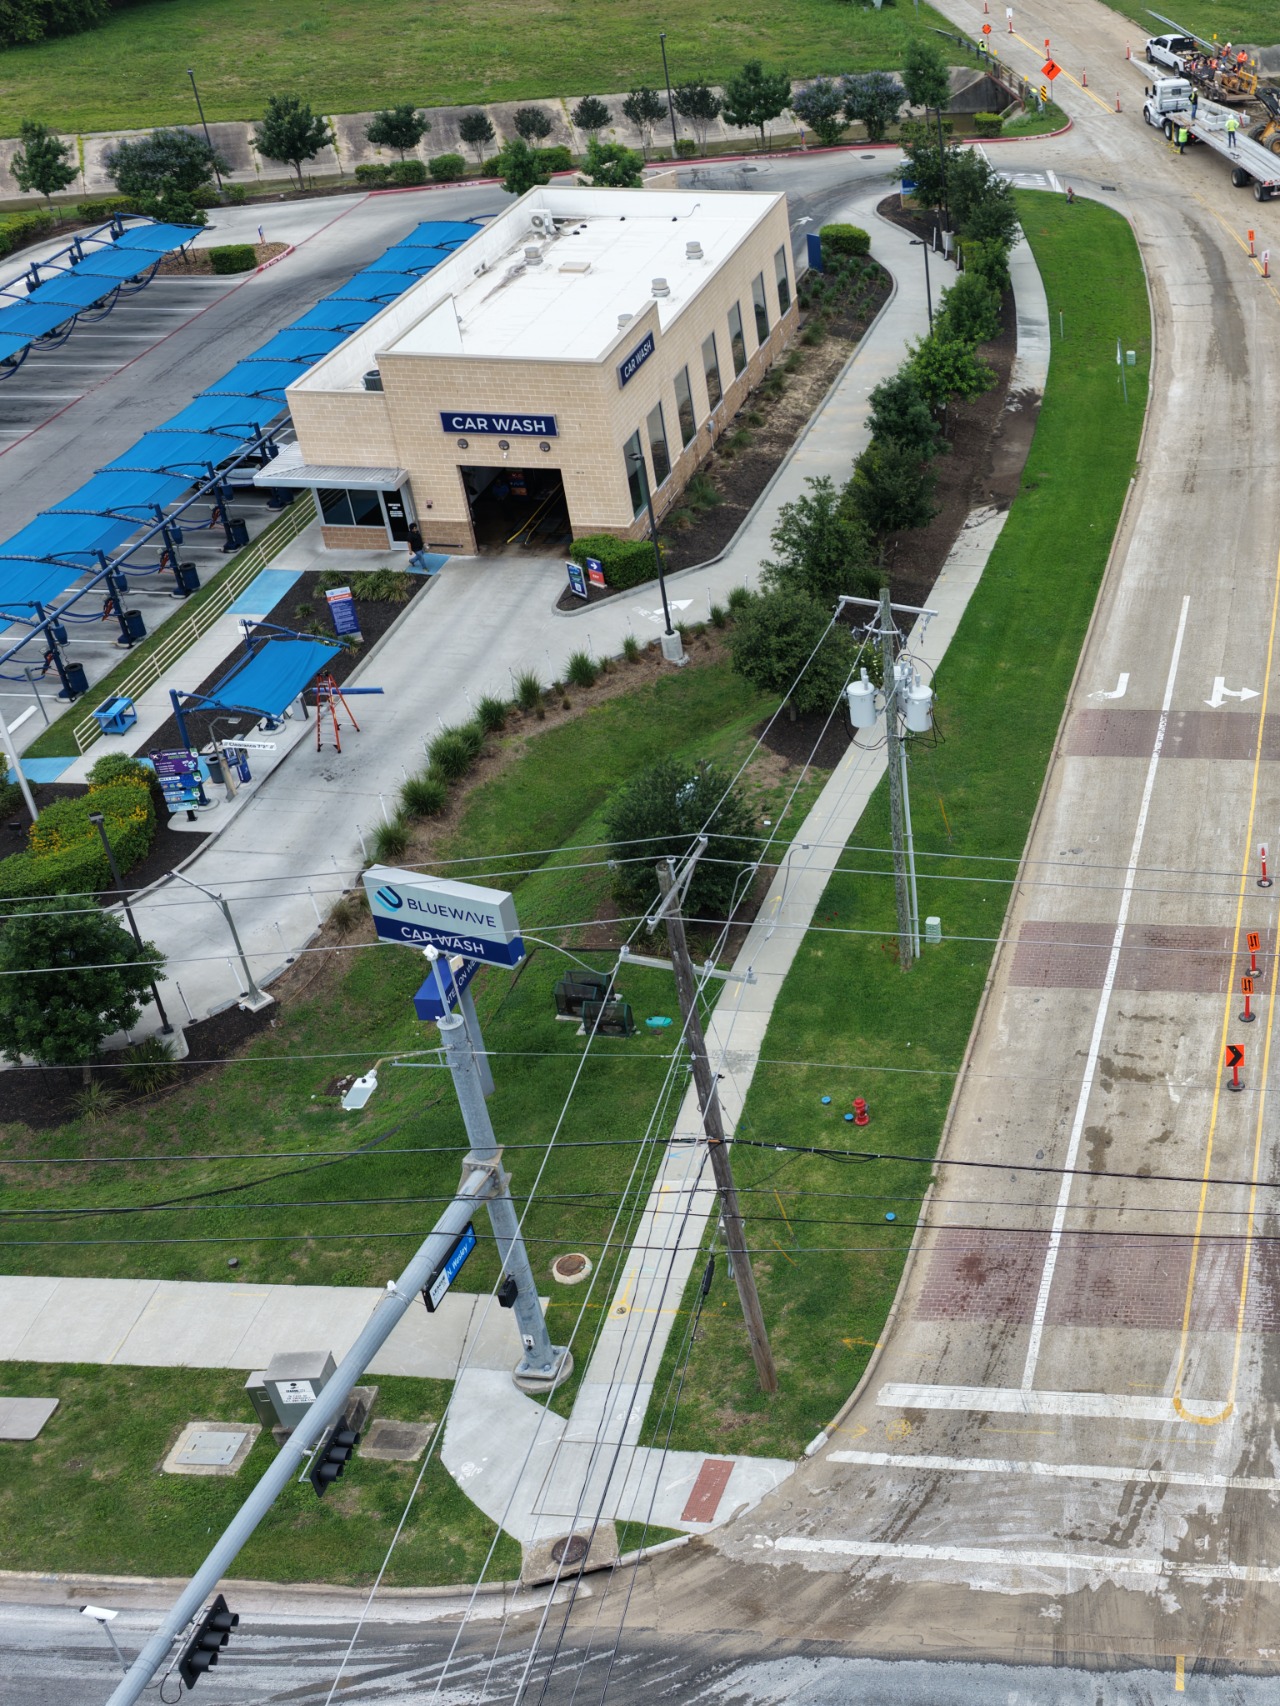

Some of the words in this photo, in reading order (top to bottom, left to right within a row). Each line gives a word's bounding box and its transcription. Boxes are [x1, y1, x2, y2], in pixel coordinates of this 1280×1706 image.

[624, 358, 636, 378] CAR
[635, 339, 652, 364] WASH
[452, 417, 488, 430] CAR
[492, 418, 546, 432] WASH
[407, 898, 497, 928] BLUEWAVE
[401, 926, 433, 944] CAR
[436, 933, 485, 955] WASH
[458, 972, 468, 987] ON
[452, 1243, 468, 1271] Wesley
